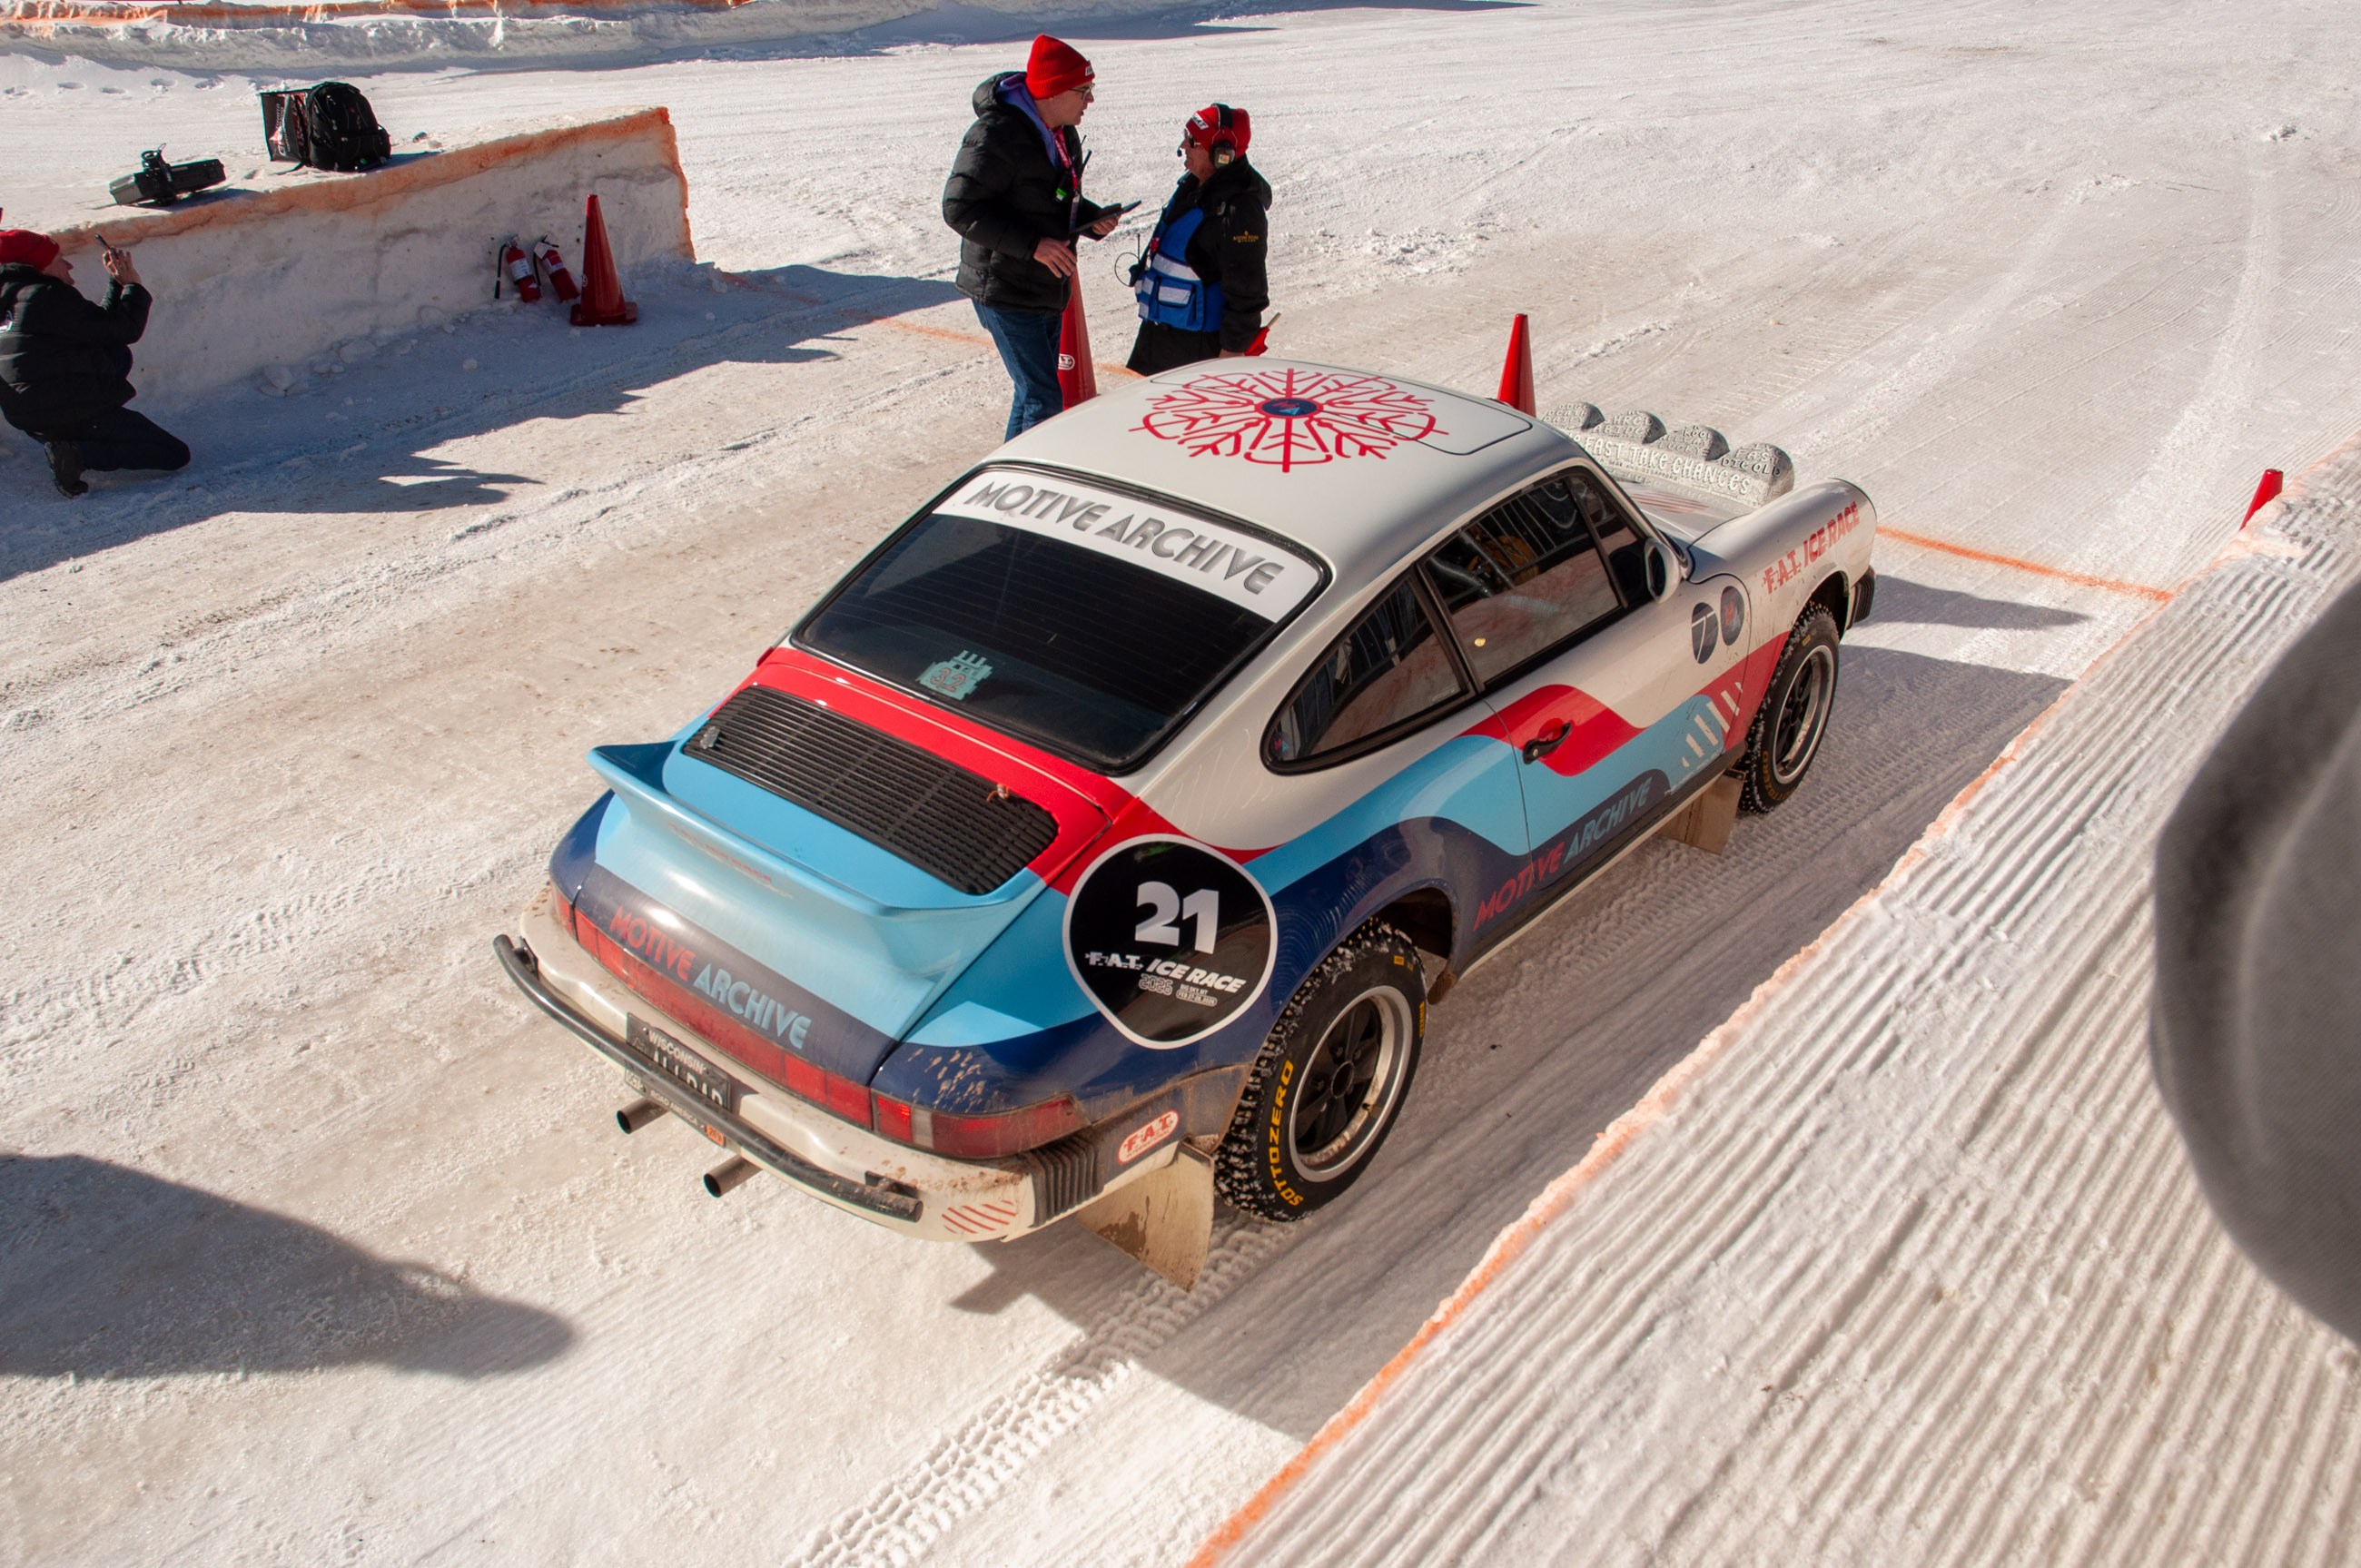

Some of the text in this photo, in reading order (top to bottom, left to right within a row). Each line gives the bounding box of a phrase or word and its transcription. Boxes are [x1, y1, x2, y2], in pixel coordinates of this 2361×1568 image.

[1585, 437, 1625, 459] FAST
[1752, 462, 1781, 478] OLD
[963, 481, 1286, 595] MOTIVE ARCHIVE
[1803, 527, 1826, 568] ICE
[1827, 501, 1860, 548] RACE
[1472, 776, 1653, 932] MOTIVE ARCHIVE
[1135, 881, 1220, 954] 21
[609, 906, 812, 1050] MOTIVE ARCHIVE
[1138, 973, 1173, 996] 2026
[1146, 958, 1191, 980] ICE
[1185, 968, 1247, 993] RACE
[648, 1030, 705, 1075] WISCONSIN
[1269, 1060, 1304, 1206] SOTTOZERO
